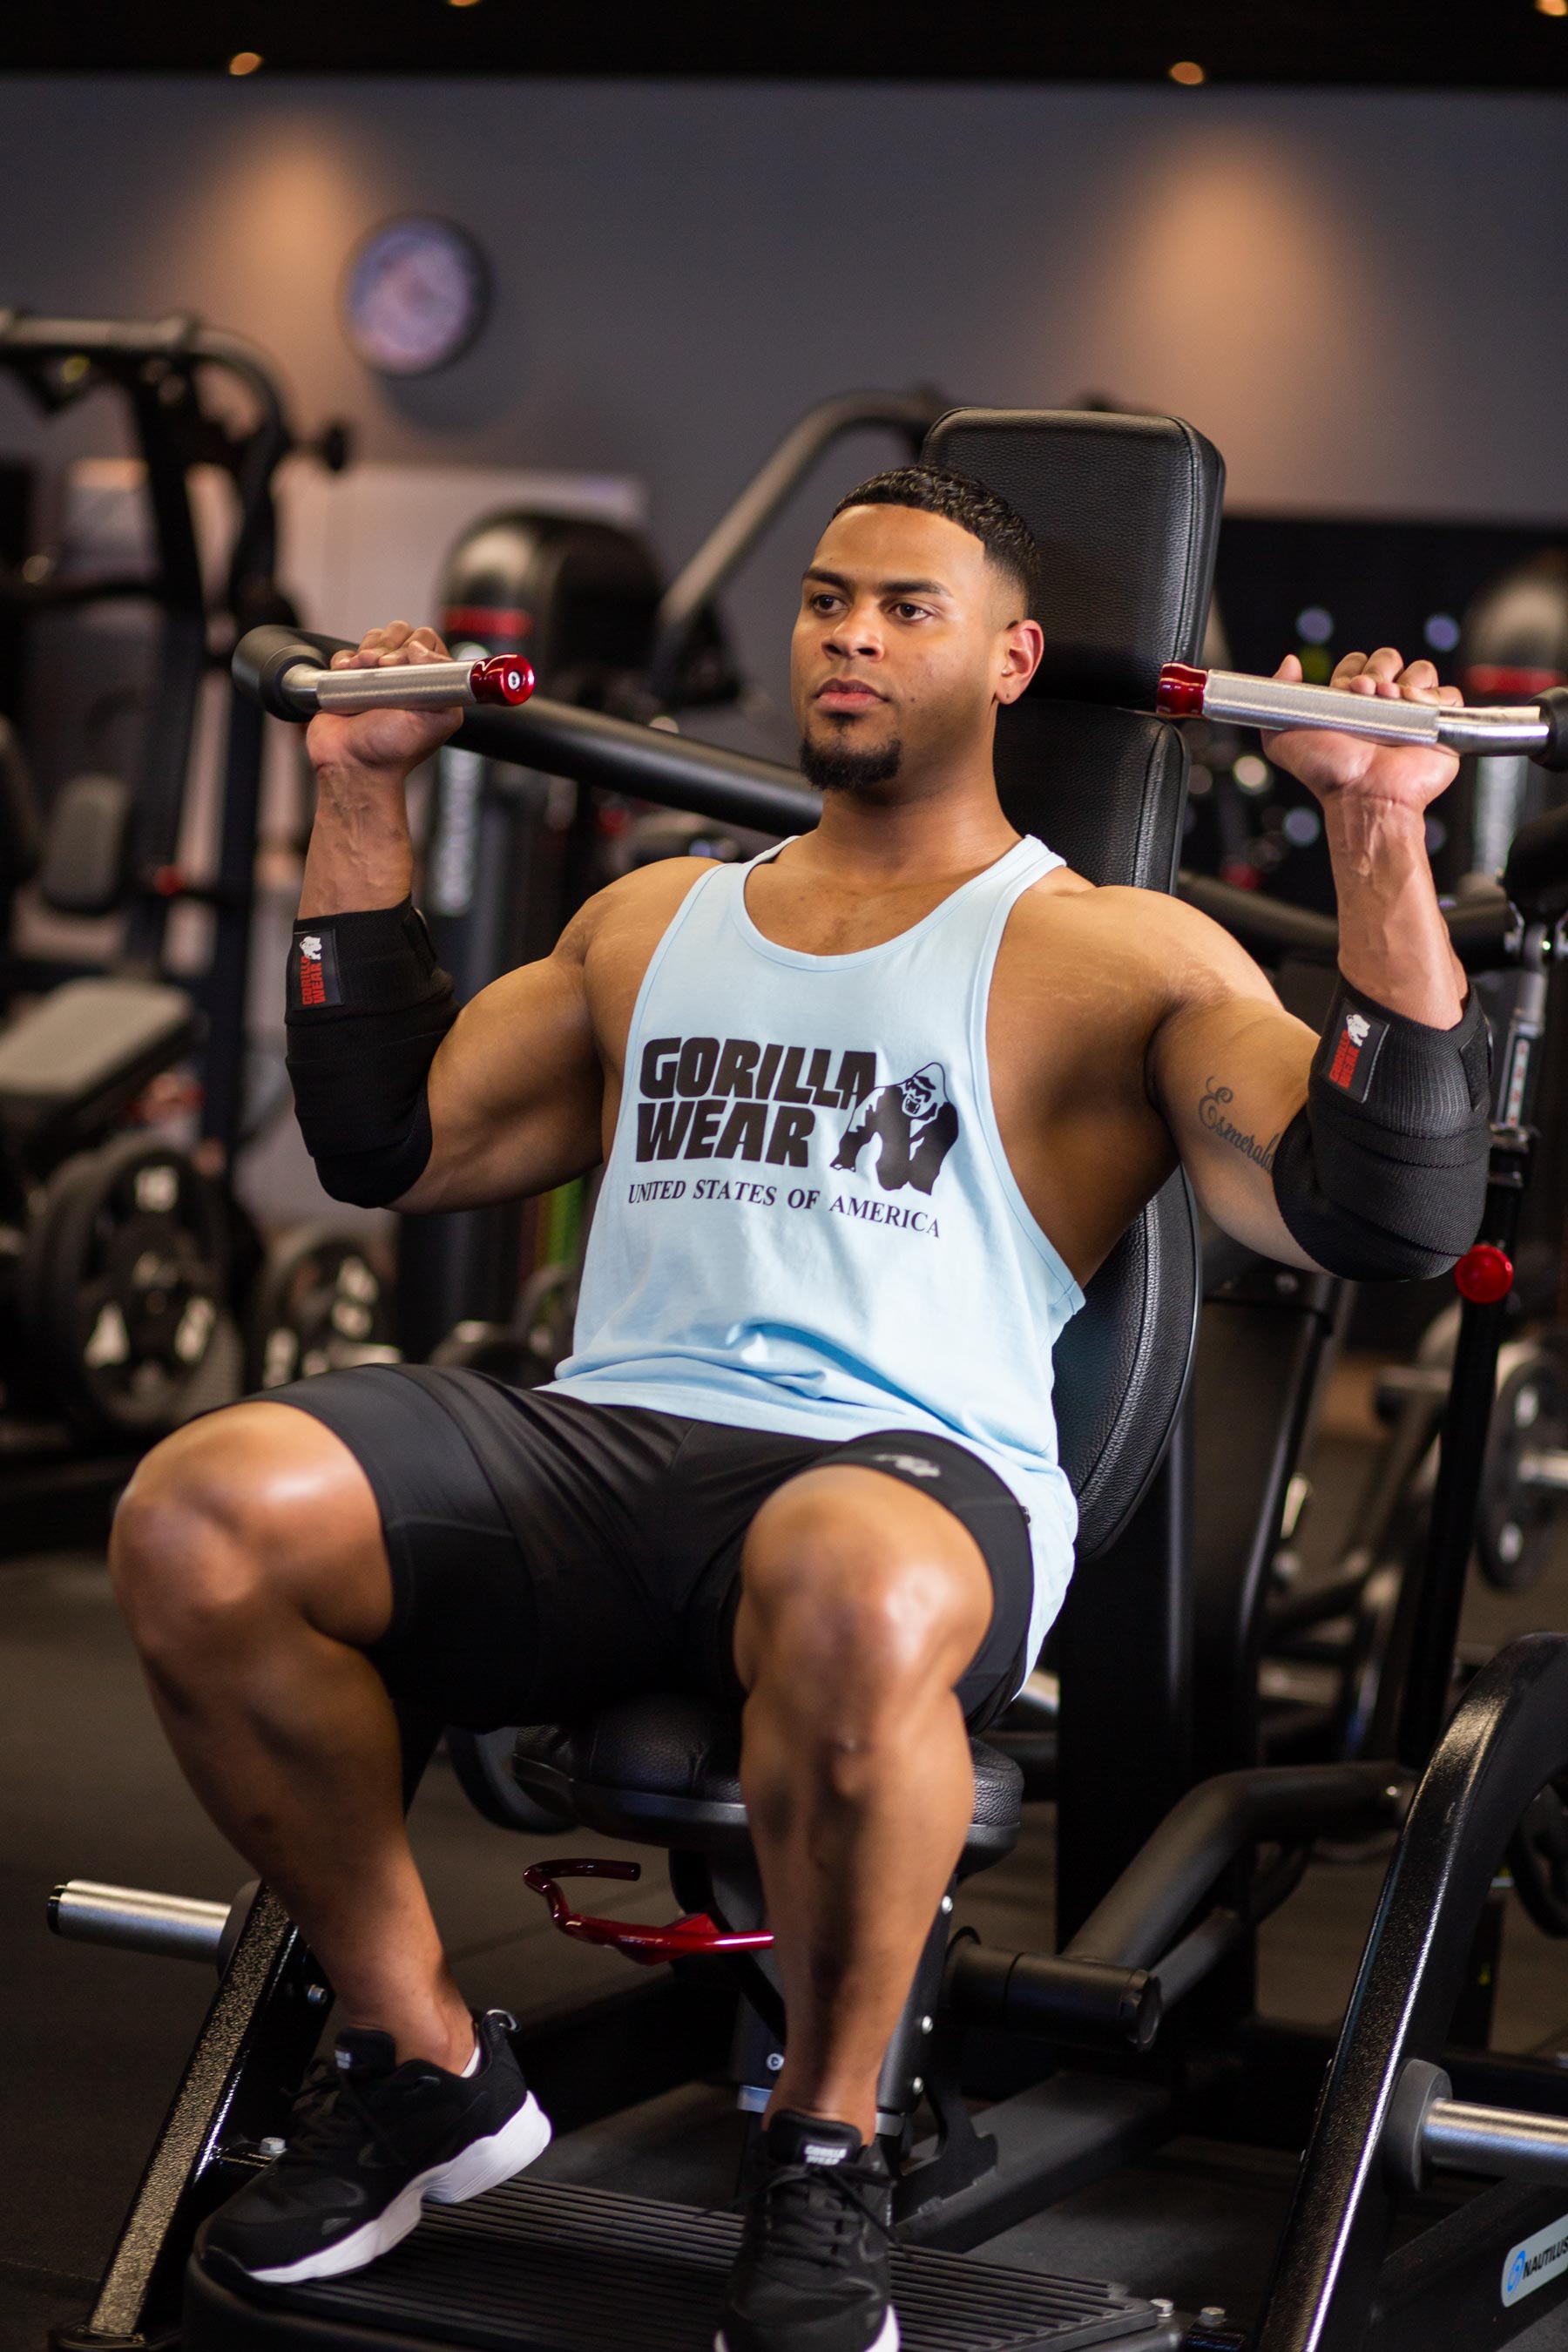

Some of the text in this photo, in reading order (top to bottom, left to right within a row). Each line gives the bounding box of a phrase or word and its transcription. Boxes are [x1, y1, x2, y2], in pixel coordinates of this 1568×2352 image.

[301, 956, 313, 1005] GORILLA
[310, 963, 326, 1004] WEAR
[639, 1037, 876, 1110] GORILLA
[636, 1099, 815, 1167] WEAR
[628, 1179, 940, 1238] UNITED STATES OF AMERICA
[1523, 2236, 1568, 2279] NAUTILUS
